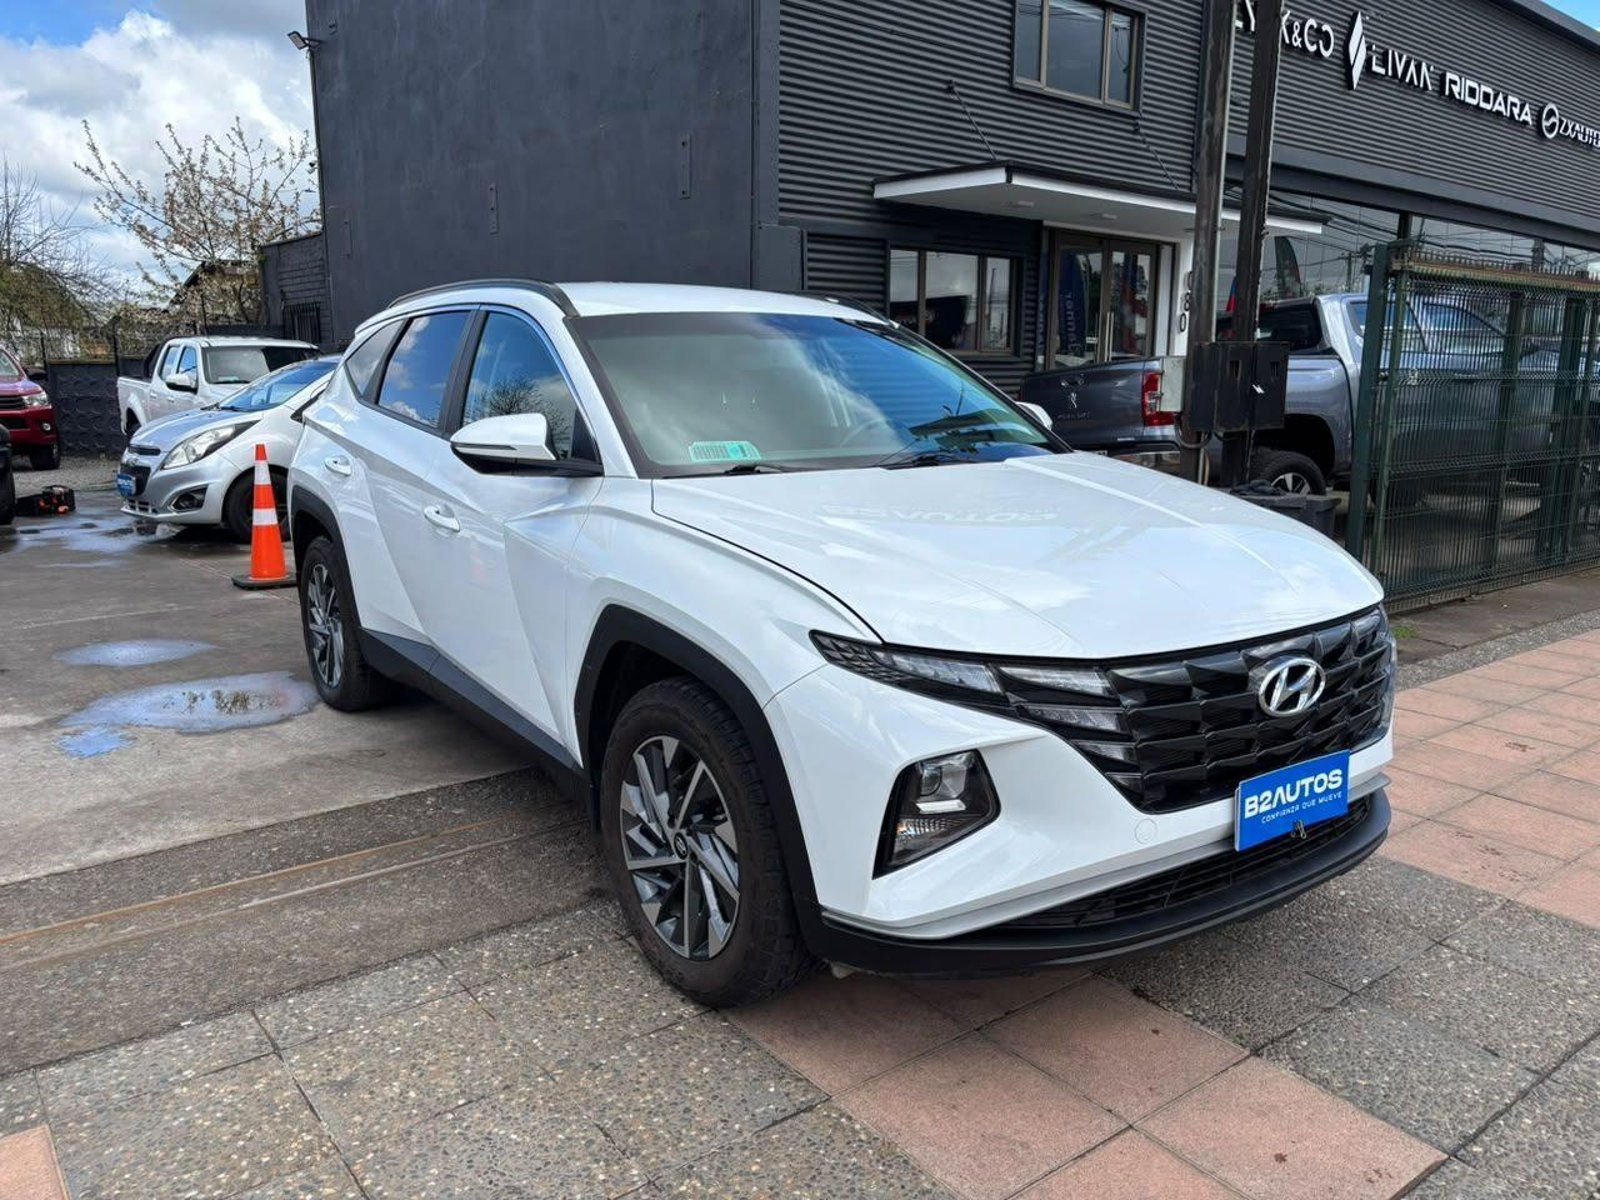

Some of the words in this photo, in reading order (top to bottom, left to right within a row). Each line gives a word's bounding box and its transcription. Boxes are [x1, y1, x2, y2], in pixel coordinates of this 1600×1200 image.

[1371, 44, 1434, 91] LIVAN
[1445, 71, 1533, 126] RIDDARA
[1244, 769, 1343, 819] B2AUTOS
[1261, 804, 1300, 824] CONFIANZA
[1302, 798, 1316, 810] QUE
[1318, 791, 1343, 804] MUEVE
